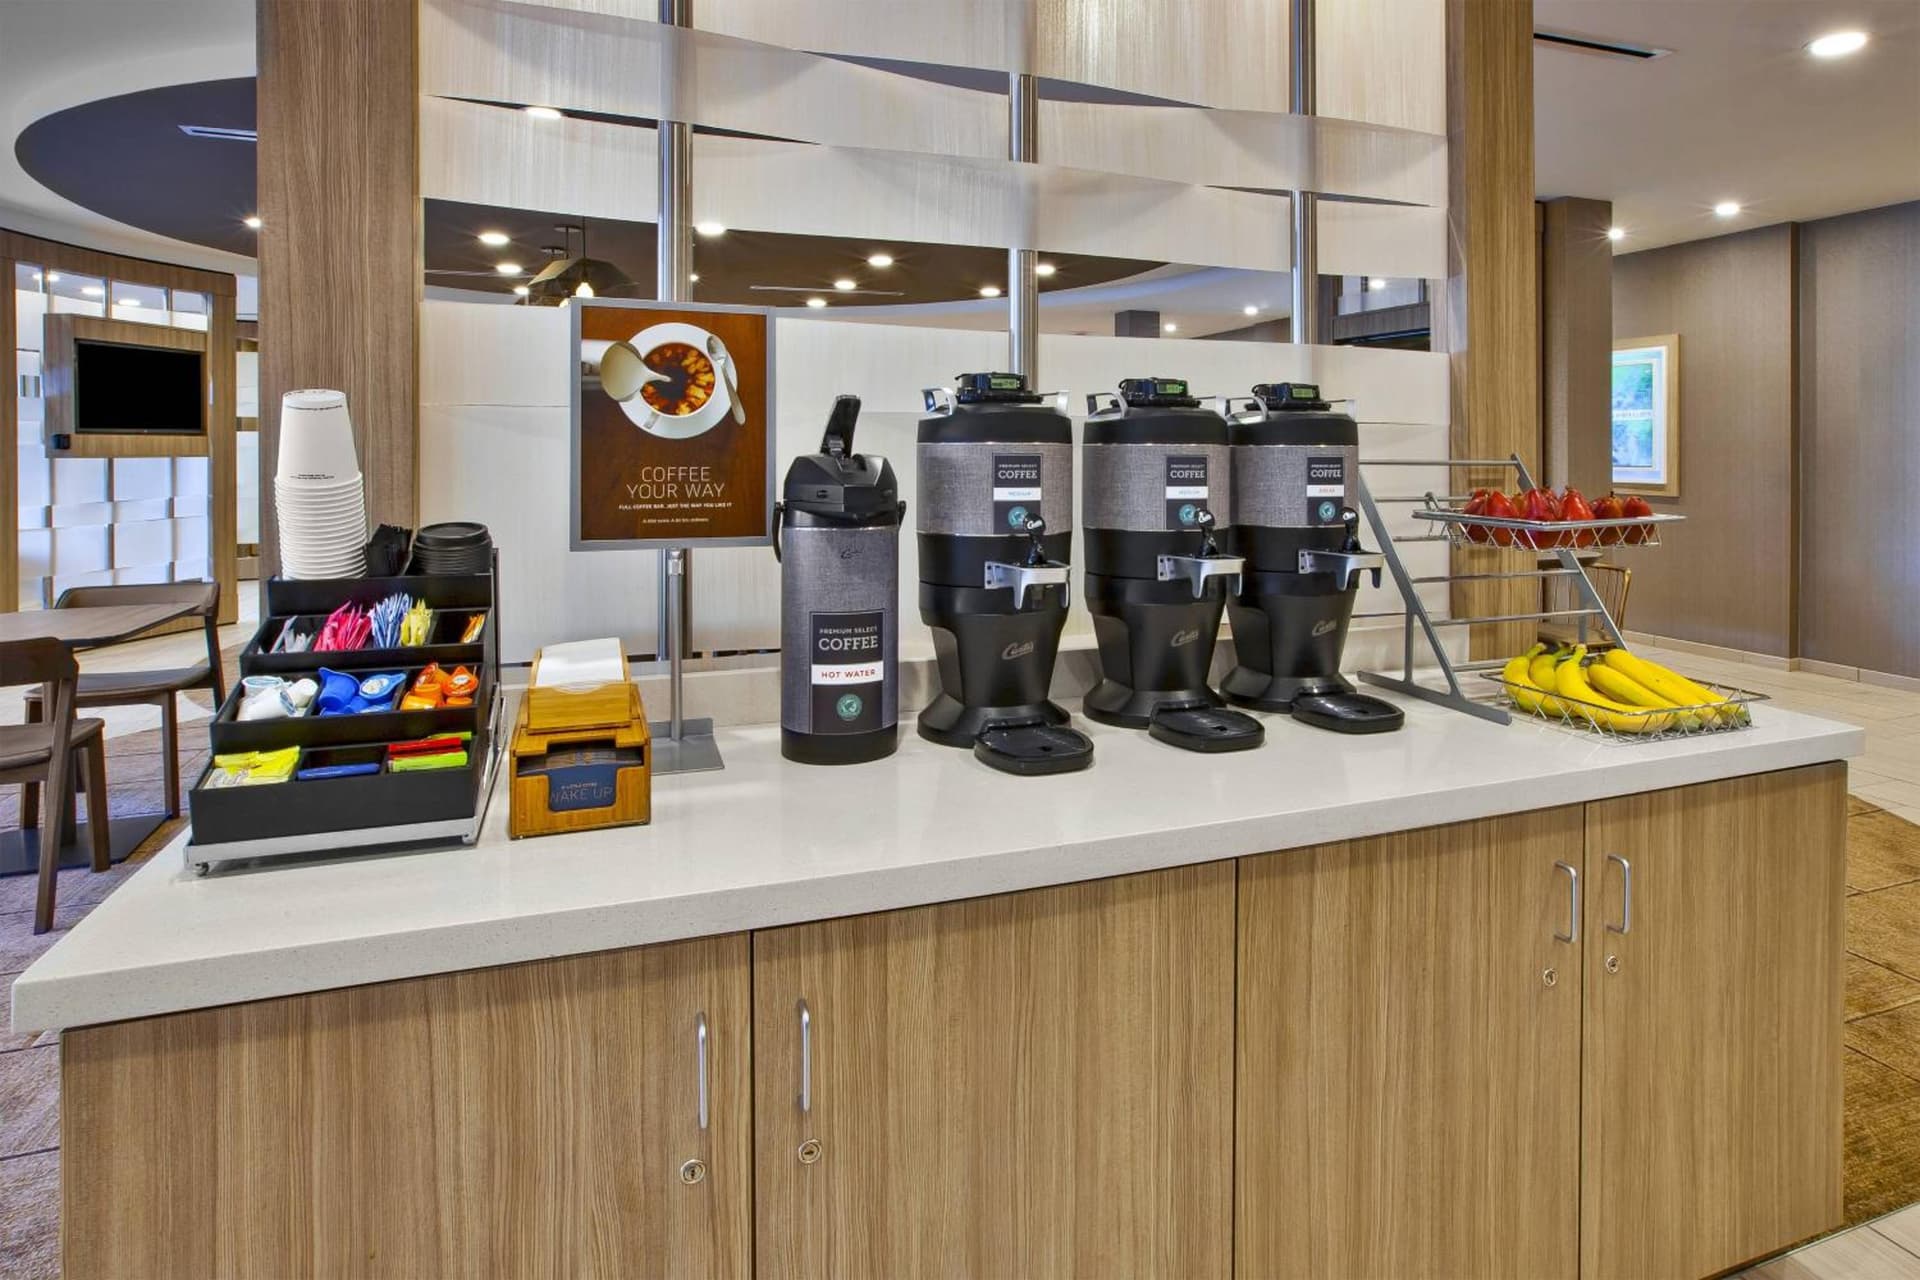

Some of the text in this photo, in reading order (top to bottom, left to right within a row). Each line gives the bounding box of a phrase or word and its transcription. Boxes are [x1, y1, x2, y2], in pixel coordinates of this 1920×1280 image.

[641, 466, 711, 482] COFFEE
[998, 470, 1038, 479] COFFEE
[1170, 470, 1206, 479] COFFEE
[626, 482, 725, 499] YOUR WAY
[854, 625, 878, 633] SELECT
[818, 636, 879, 650] COFFEE
[844, 669, 876, 678] WATER
[592, 786, 614, 800] UP
